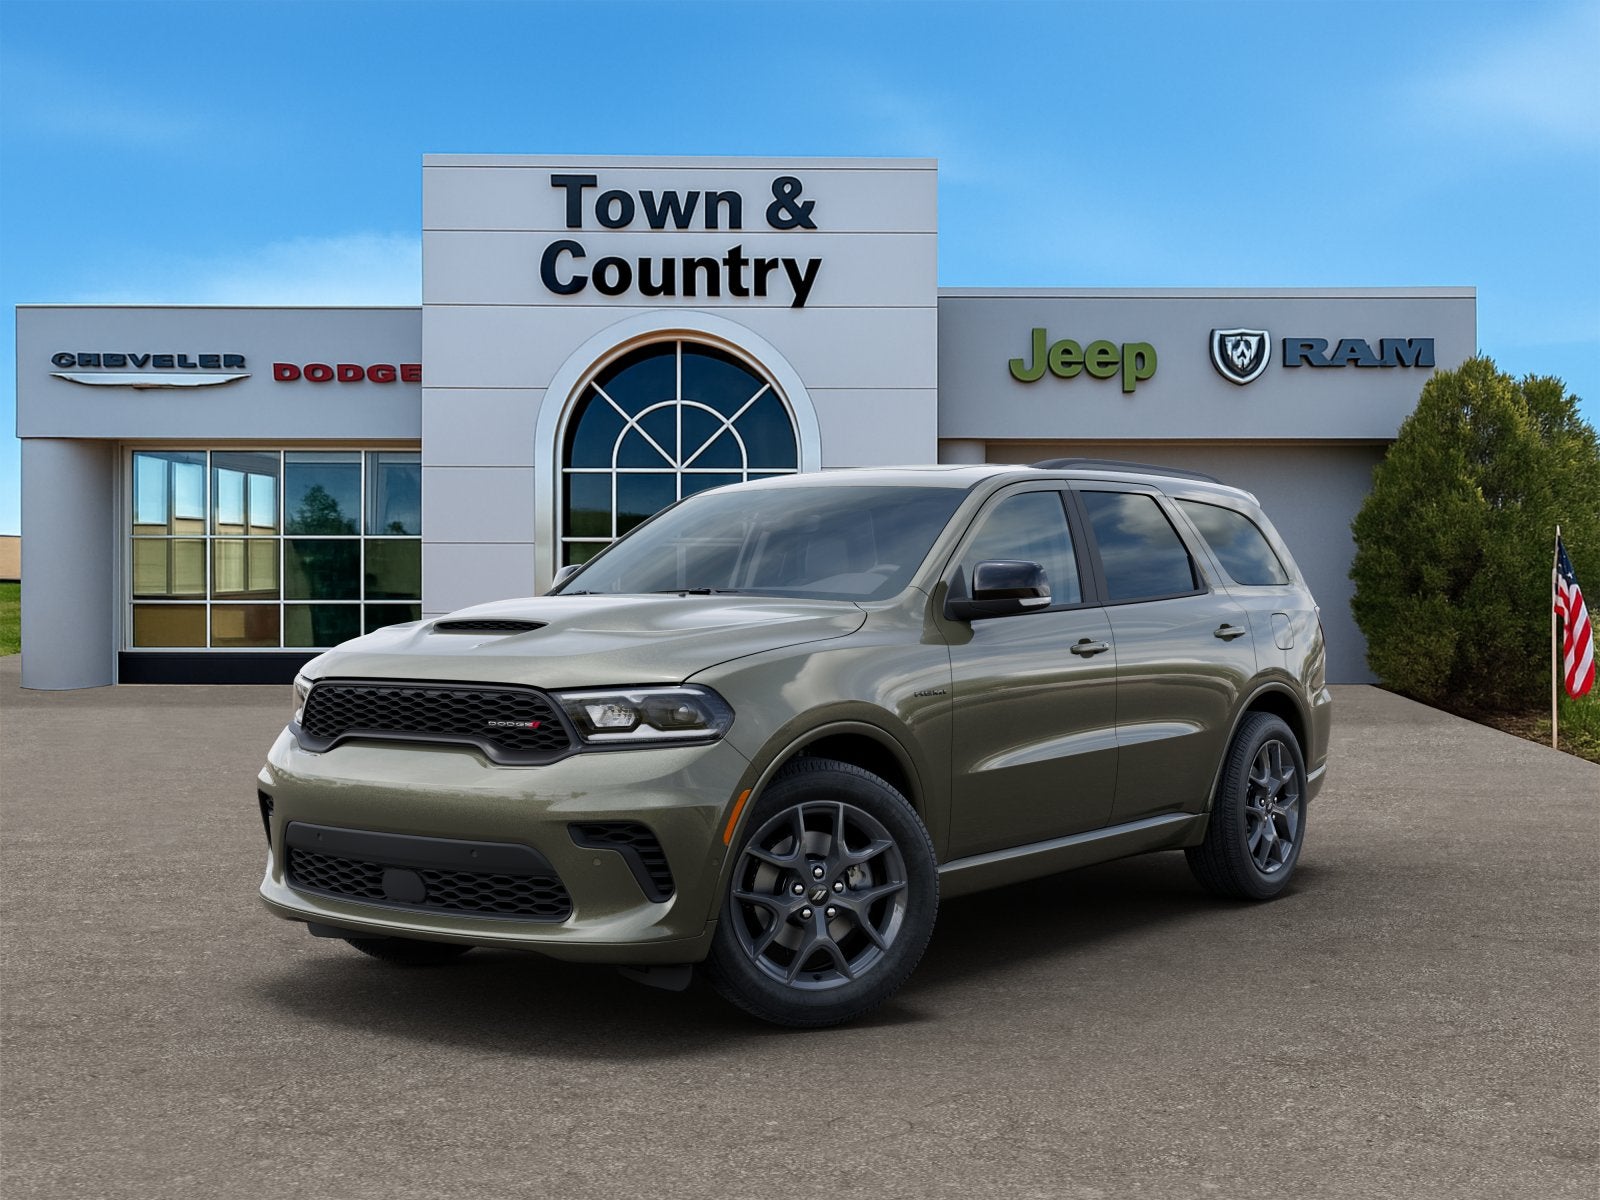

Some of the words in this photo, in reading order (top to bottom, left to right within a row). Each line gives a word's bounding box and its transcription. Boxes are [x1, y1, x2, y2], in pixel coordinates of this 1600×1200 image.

[551, 174, 743, 230] Town
[765, 176, 818, 231] &
[540, 239, 823, 309] Country
[273, 363, 422, 383] DODGE
[1009, 328, 1158, 393] Jeep
[1282, 337, 1436, 368] RAM
